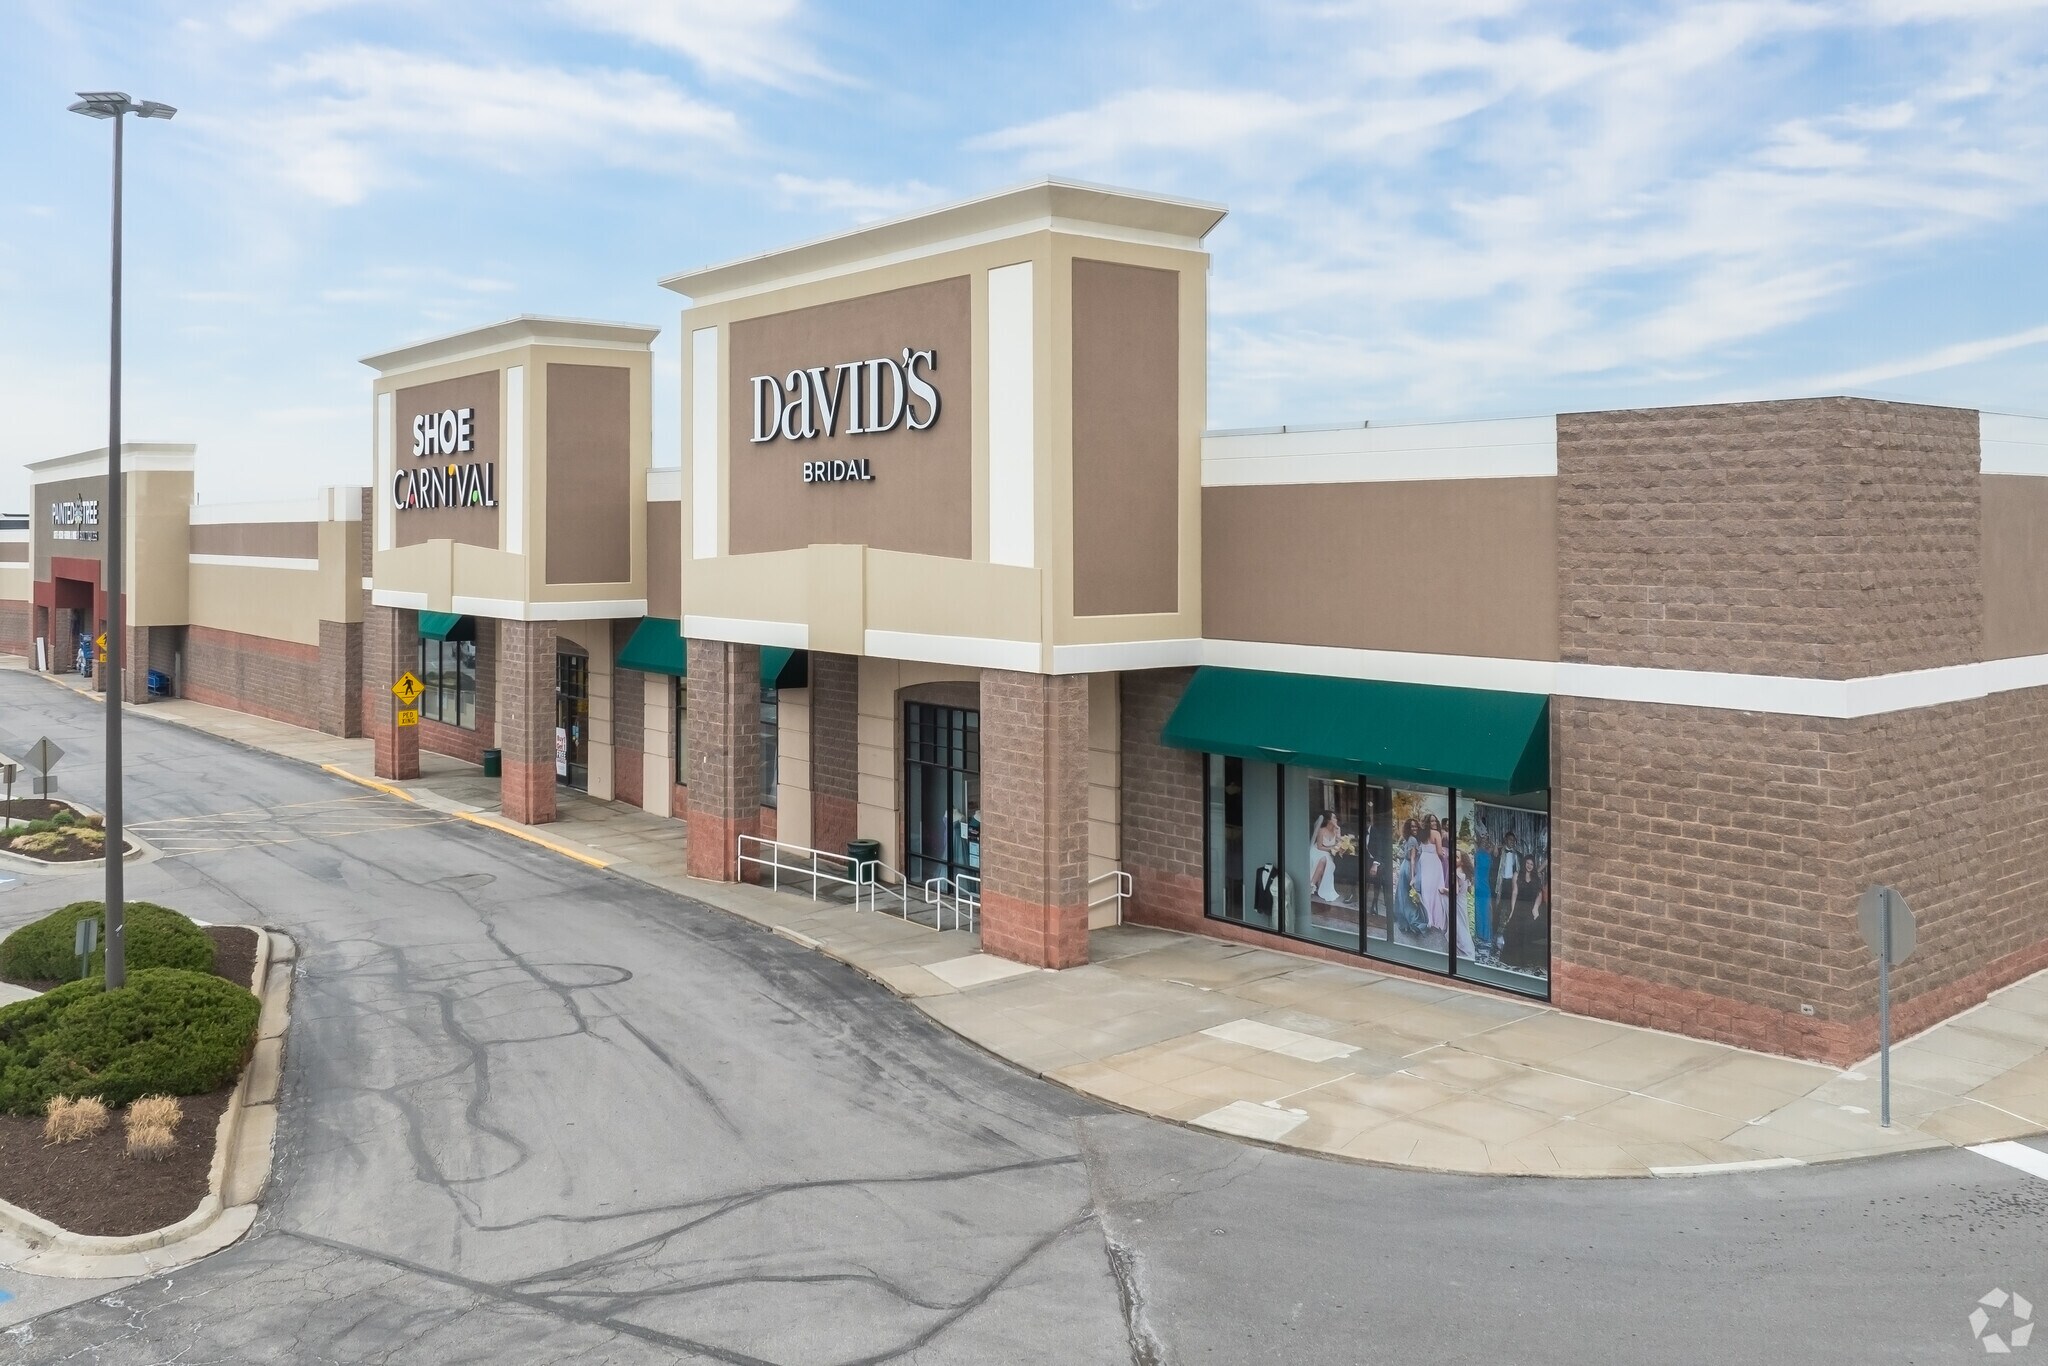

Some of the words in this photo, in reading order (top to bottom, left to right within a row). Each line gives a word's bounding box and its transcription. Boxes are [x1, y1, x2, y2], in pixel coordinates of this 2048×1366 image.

[413, 408, 474, 457] SHOE
[803, 458, 875, 483] BRIDAL
[52, 501, 75, 525] PAINTED
[82, 500, 99, 525] TREE
